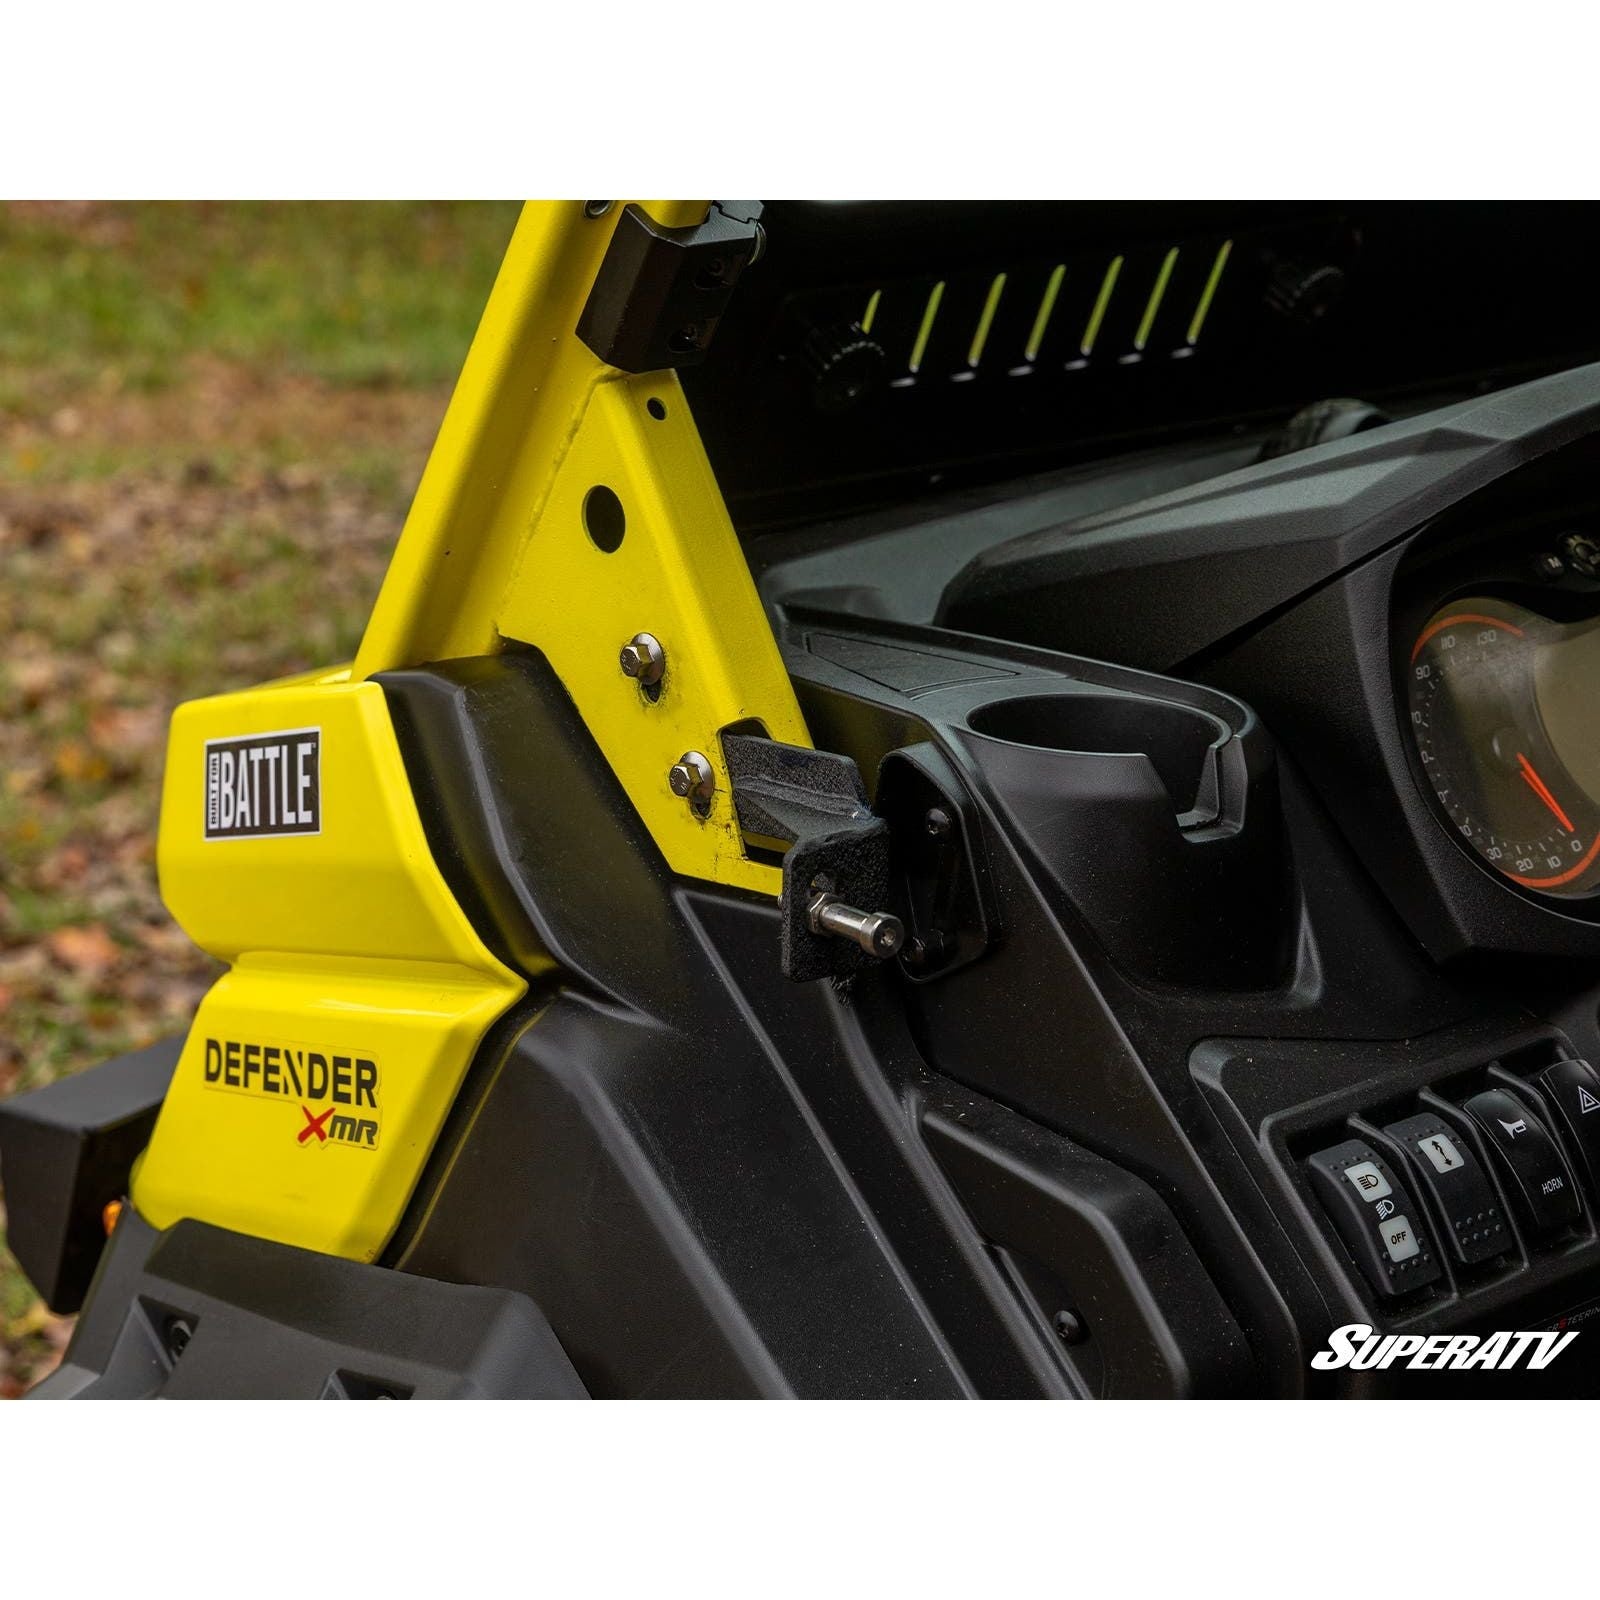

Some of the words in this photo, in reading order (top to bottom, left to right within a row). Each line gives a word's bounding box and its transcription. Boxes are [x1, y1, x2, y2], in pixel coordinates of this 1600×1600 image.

[1441, 635, 1456, 650] 110
[1415, 664, 1431, 680] 90
[220, 742, 312, 829] BATTLE
[1486, 846, 1502, 860] 30
[1570, 839, 1582, 852] 0
[1516, 857, 1534, 872] 20
[1546, 855, 1561, 869] 10
[204, 1038, 377, 1109] DEFENDER
[1541, 1176, 1564, 1196] HORN
[1391, 1231, 1407, 1245] OFF
